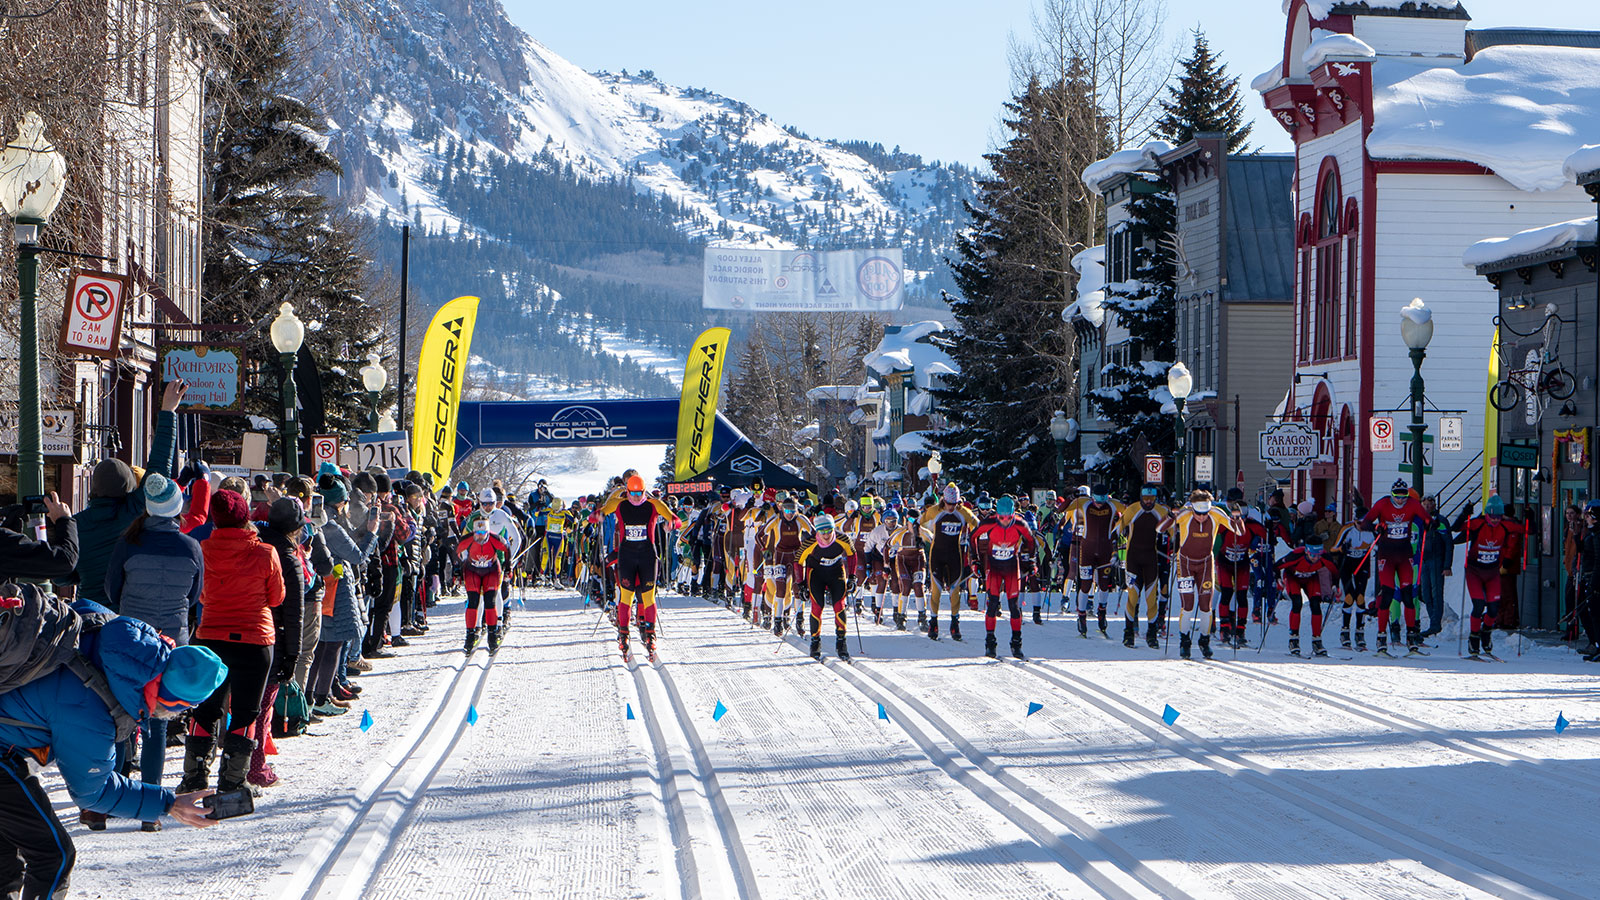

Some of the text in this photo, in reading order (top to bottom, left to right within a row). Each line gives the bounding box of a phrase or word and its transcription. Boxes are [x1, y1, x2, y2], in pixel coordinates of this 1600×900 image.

[81, 320, 101, 333] 2AM
[72, 330, 107, 346] TO 8AM
[186, 377, 227, 390] Saloon &
[209, 391, 227, 402] Hall
[431, 338, 459, 479] FISCHER
[689, 360, 714, 475] FISCHER
[1448, 420, 1454, 428] 2
[1266, 435, 1313, 446] PARAGON
[363, 442, 405, 471] 21K
[1267, 446, 1312, 457] GALLERY
[1503, 449, 1535, 462] CLOSED
[628, 529, 643, 537] 397
[944, 525, 958, 533] 471
[1390, 527, 1405, 535] 437
[995, 549, 1011, 557] 440
[1178, 579, 1193, 588] 464
